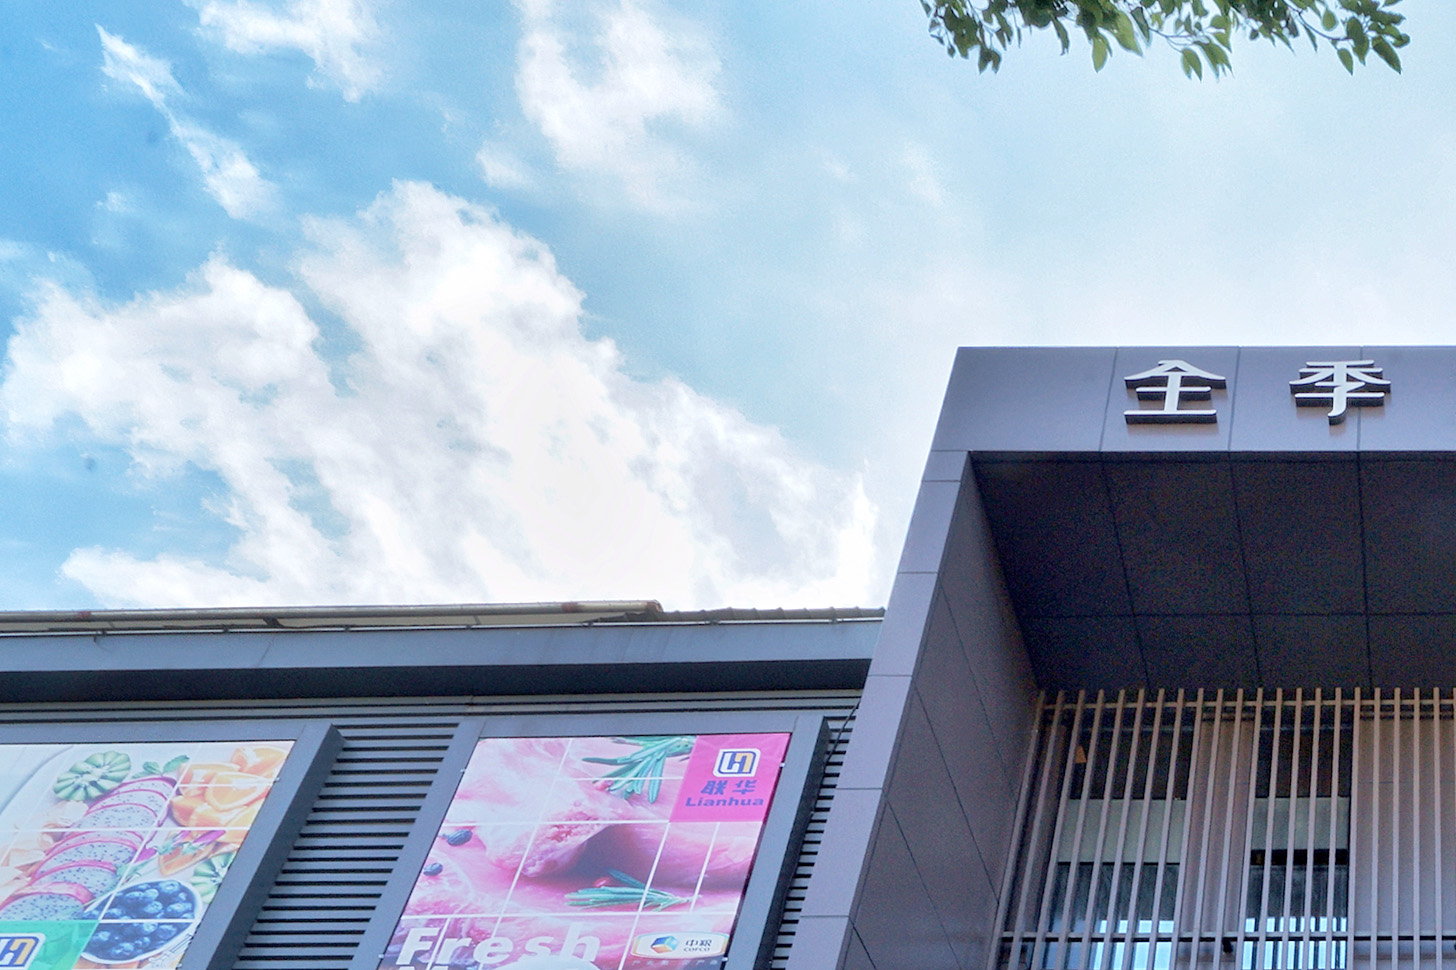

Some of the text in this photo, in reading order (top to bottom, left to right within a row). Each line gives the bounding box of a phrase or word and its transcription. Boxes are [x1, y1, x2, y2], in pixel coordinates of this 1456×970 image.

[700, 780, 758, 795] 联华
[685, 797, 764, 807] Lianhua
[396, 921, 601, 966] Fresh
